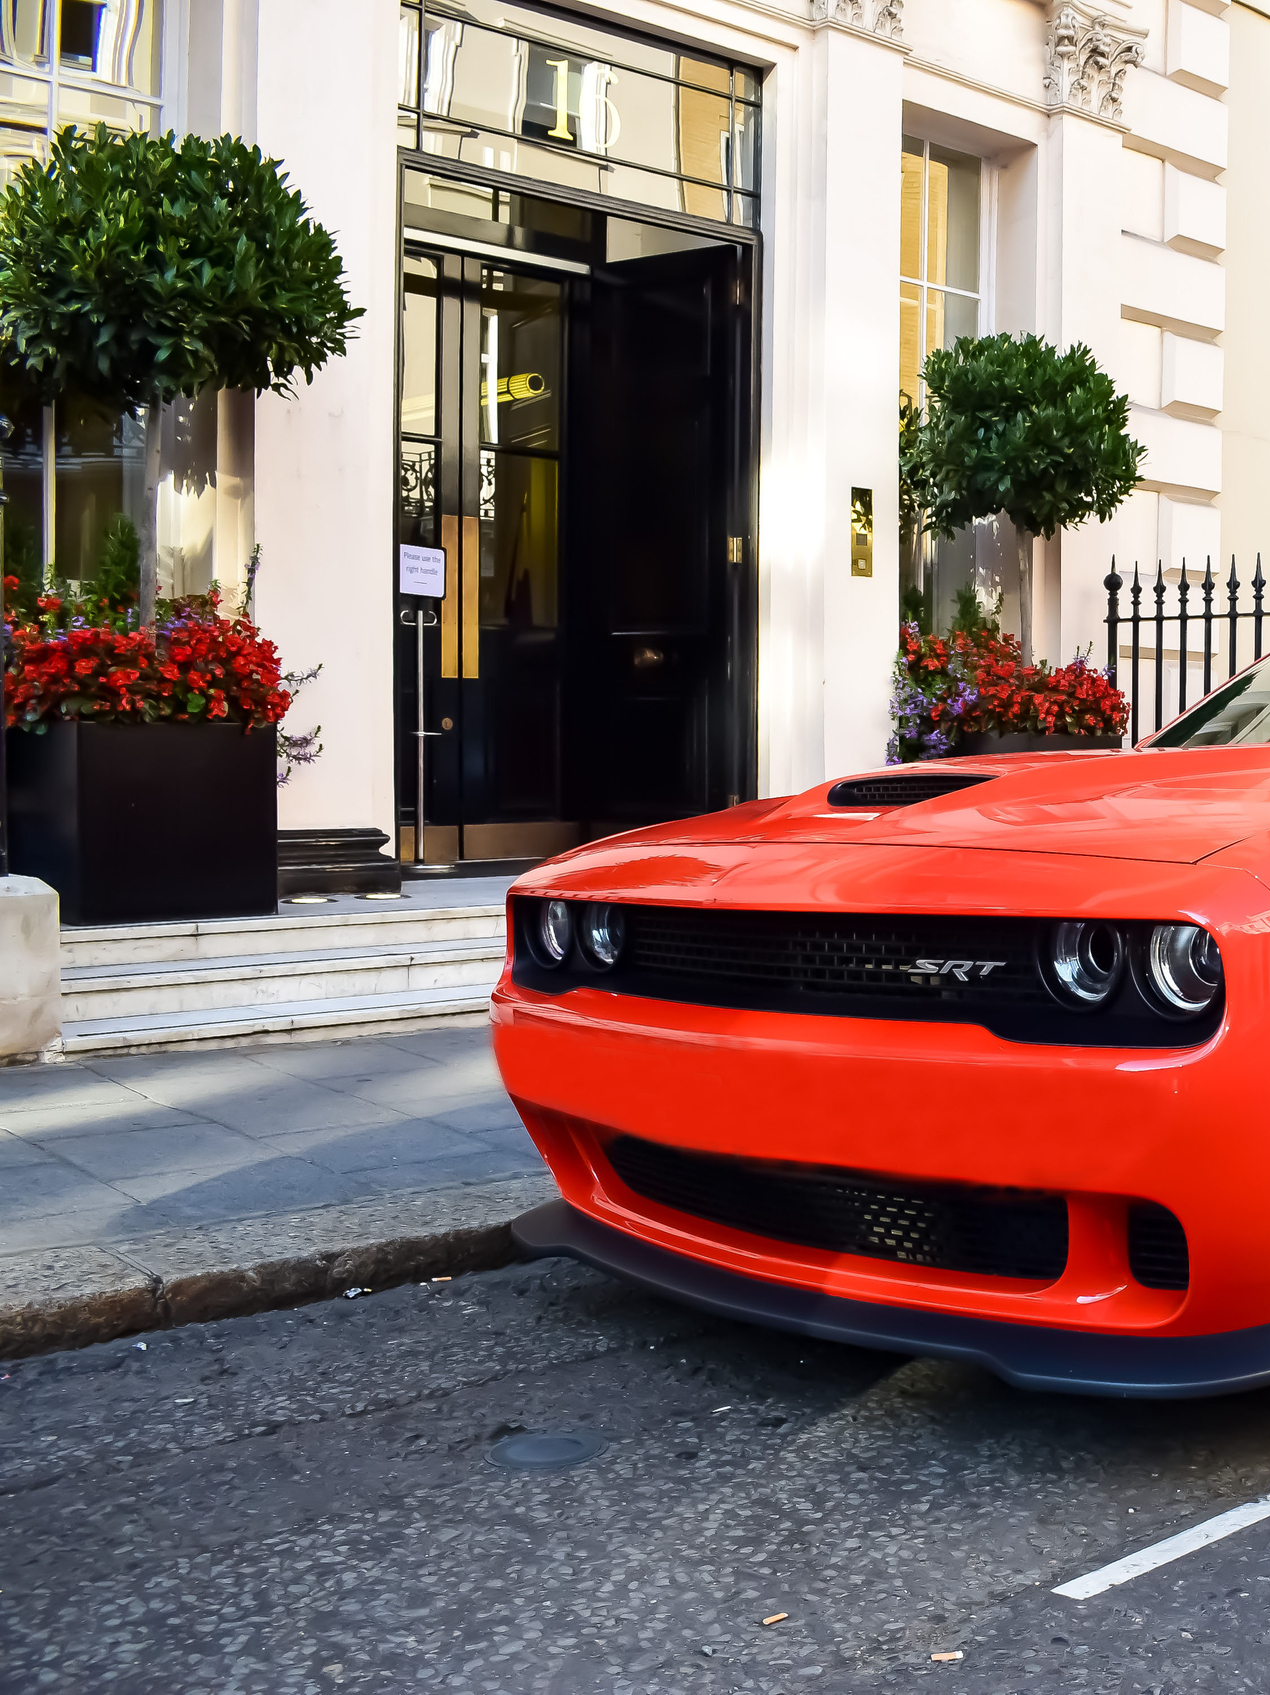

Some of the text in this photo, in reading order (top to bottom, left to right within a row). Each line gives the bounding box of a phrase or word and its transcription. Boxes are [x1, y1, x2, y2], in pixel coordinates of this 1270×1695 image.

[545, 59, 621, 149] 16
[404, 552, 420, 561] Please
[406, 566, 438, 575] right handle
[907, 959, 1007, 982] SRT
